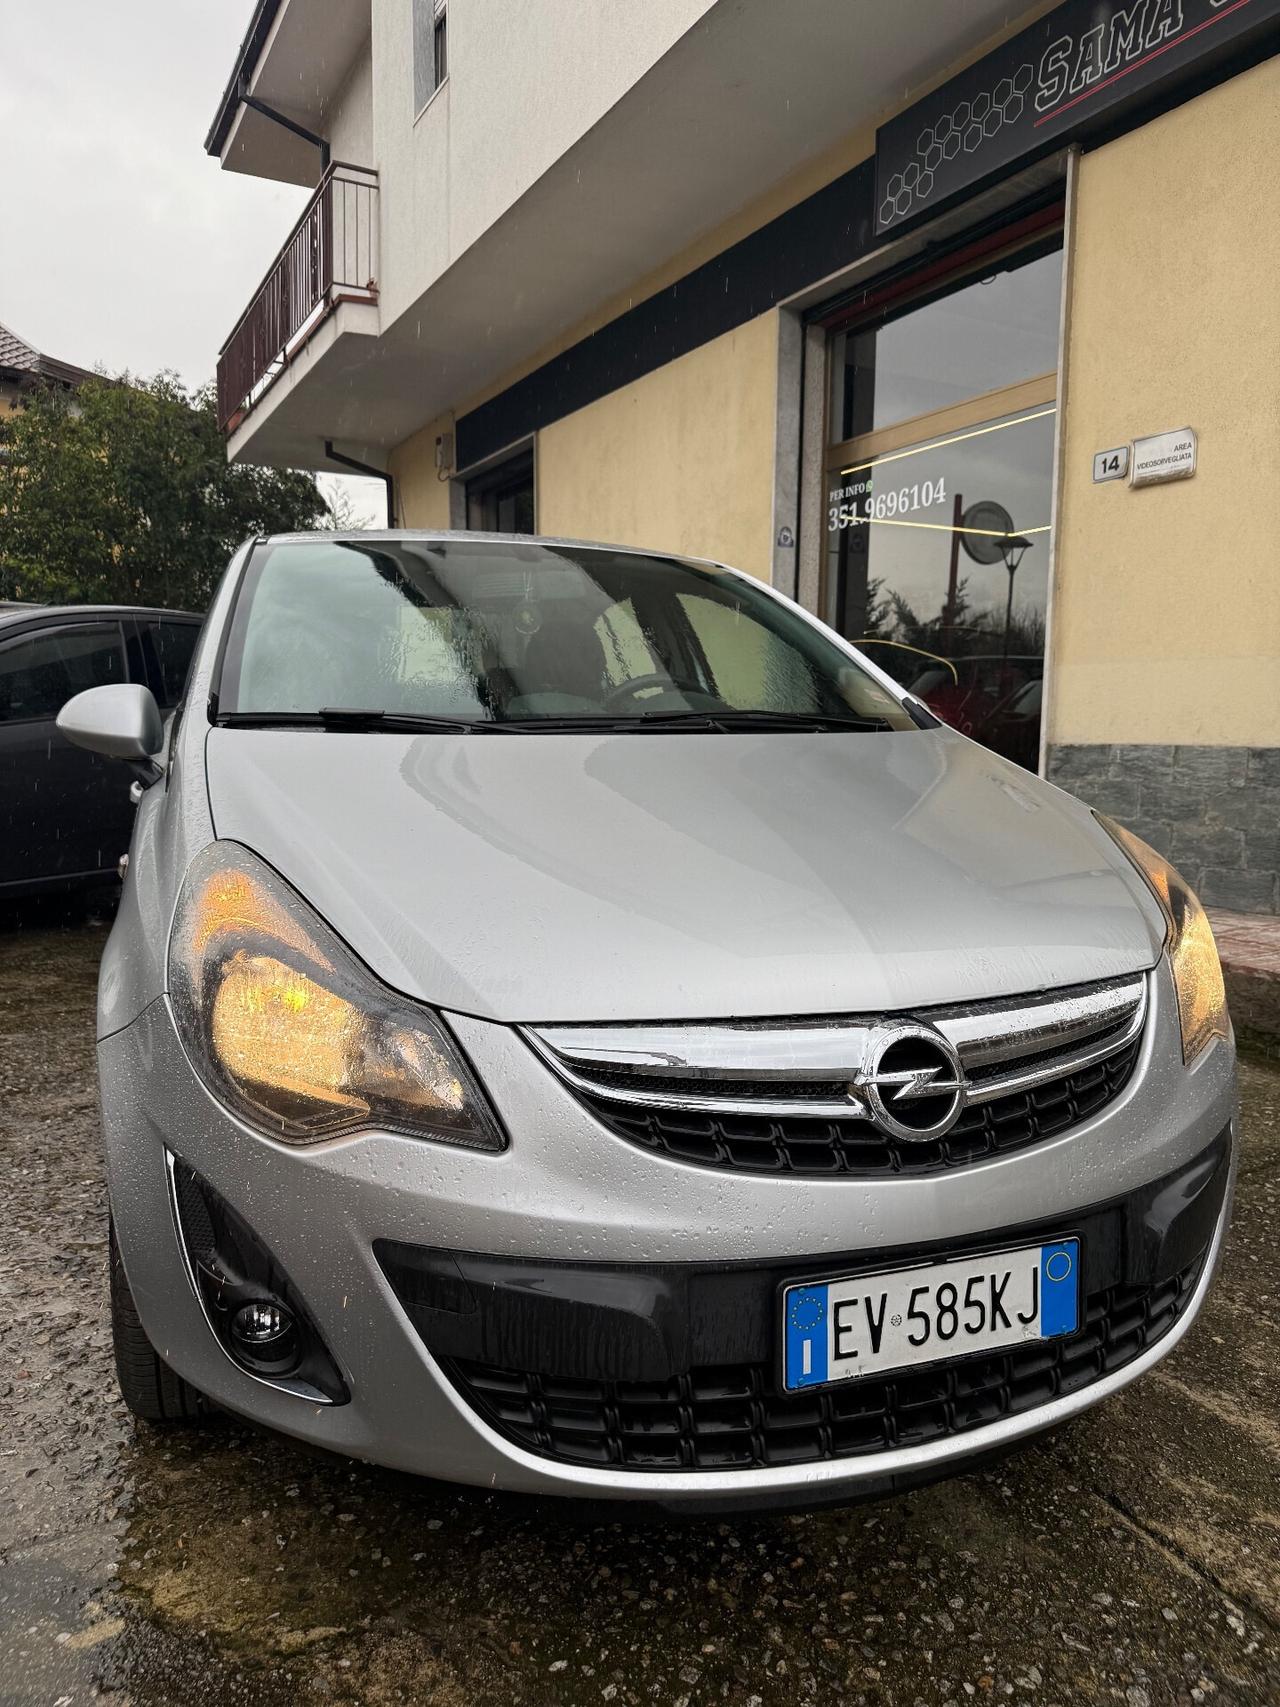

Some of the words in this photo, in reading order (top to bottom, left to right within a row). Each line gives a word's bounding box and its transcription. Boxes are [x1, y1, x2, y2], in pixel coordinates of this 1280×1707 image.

[1035, 0, 1184, 112] SAMA
[1173, 442, 1192, 452] AREA
[1102, 455, 1120, 474] 14
[1136, 452, 1192, 470] VIDEOSORVEGLIATA
[829, 489, 844, 502] PER
[845, 482, 866, 497] INFO
